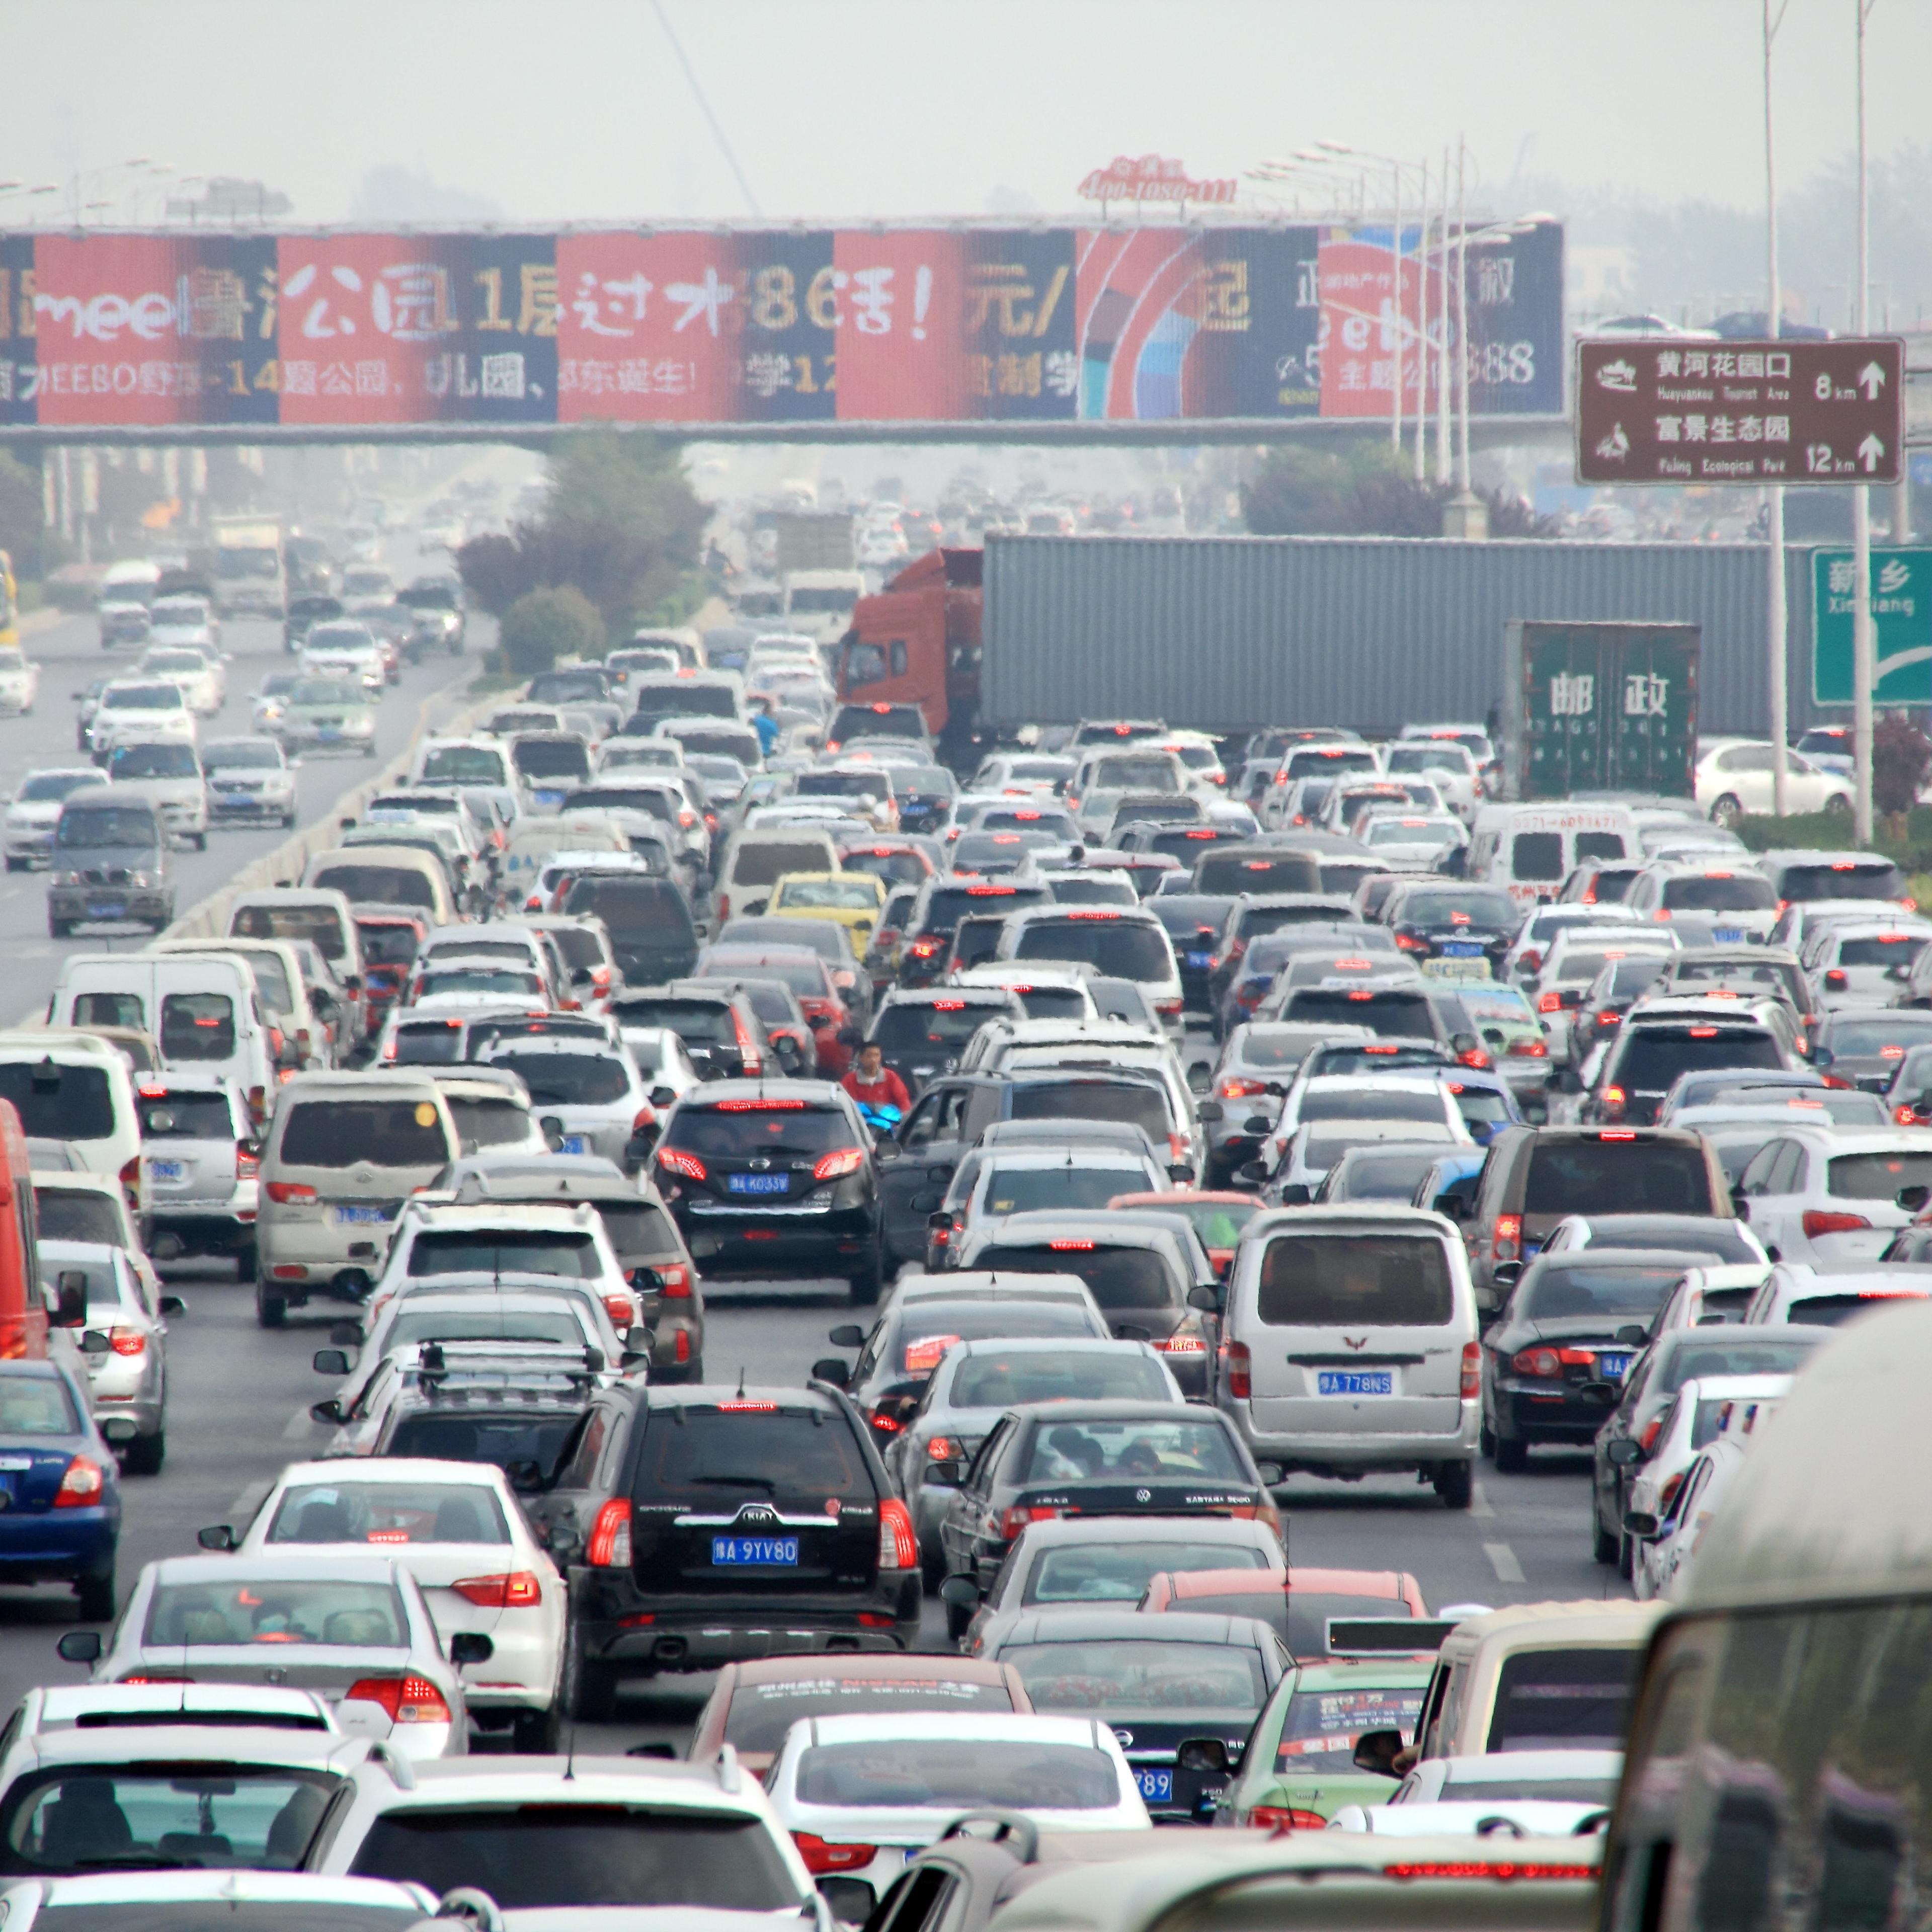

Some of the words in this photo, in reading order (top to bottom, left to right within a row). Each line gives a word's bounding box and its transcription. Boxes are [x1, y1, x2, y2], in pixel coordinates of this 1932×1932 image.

[1657, 352, 1791, 378] 黄河花园口
[1816, 374, 1831, 399] 8
[1835, 387, 1858, 399] km
[1656, 415, 1791, 443] 富景生态园
[1808, 445, 1832, 473] 12
[1835, 459, 1856, 472] km
[1551, 671, 1670, 715] 邮政
